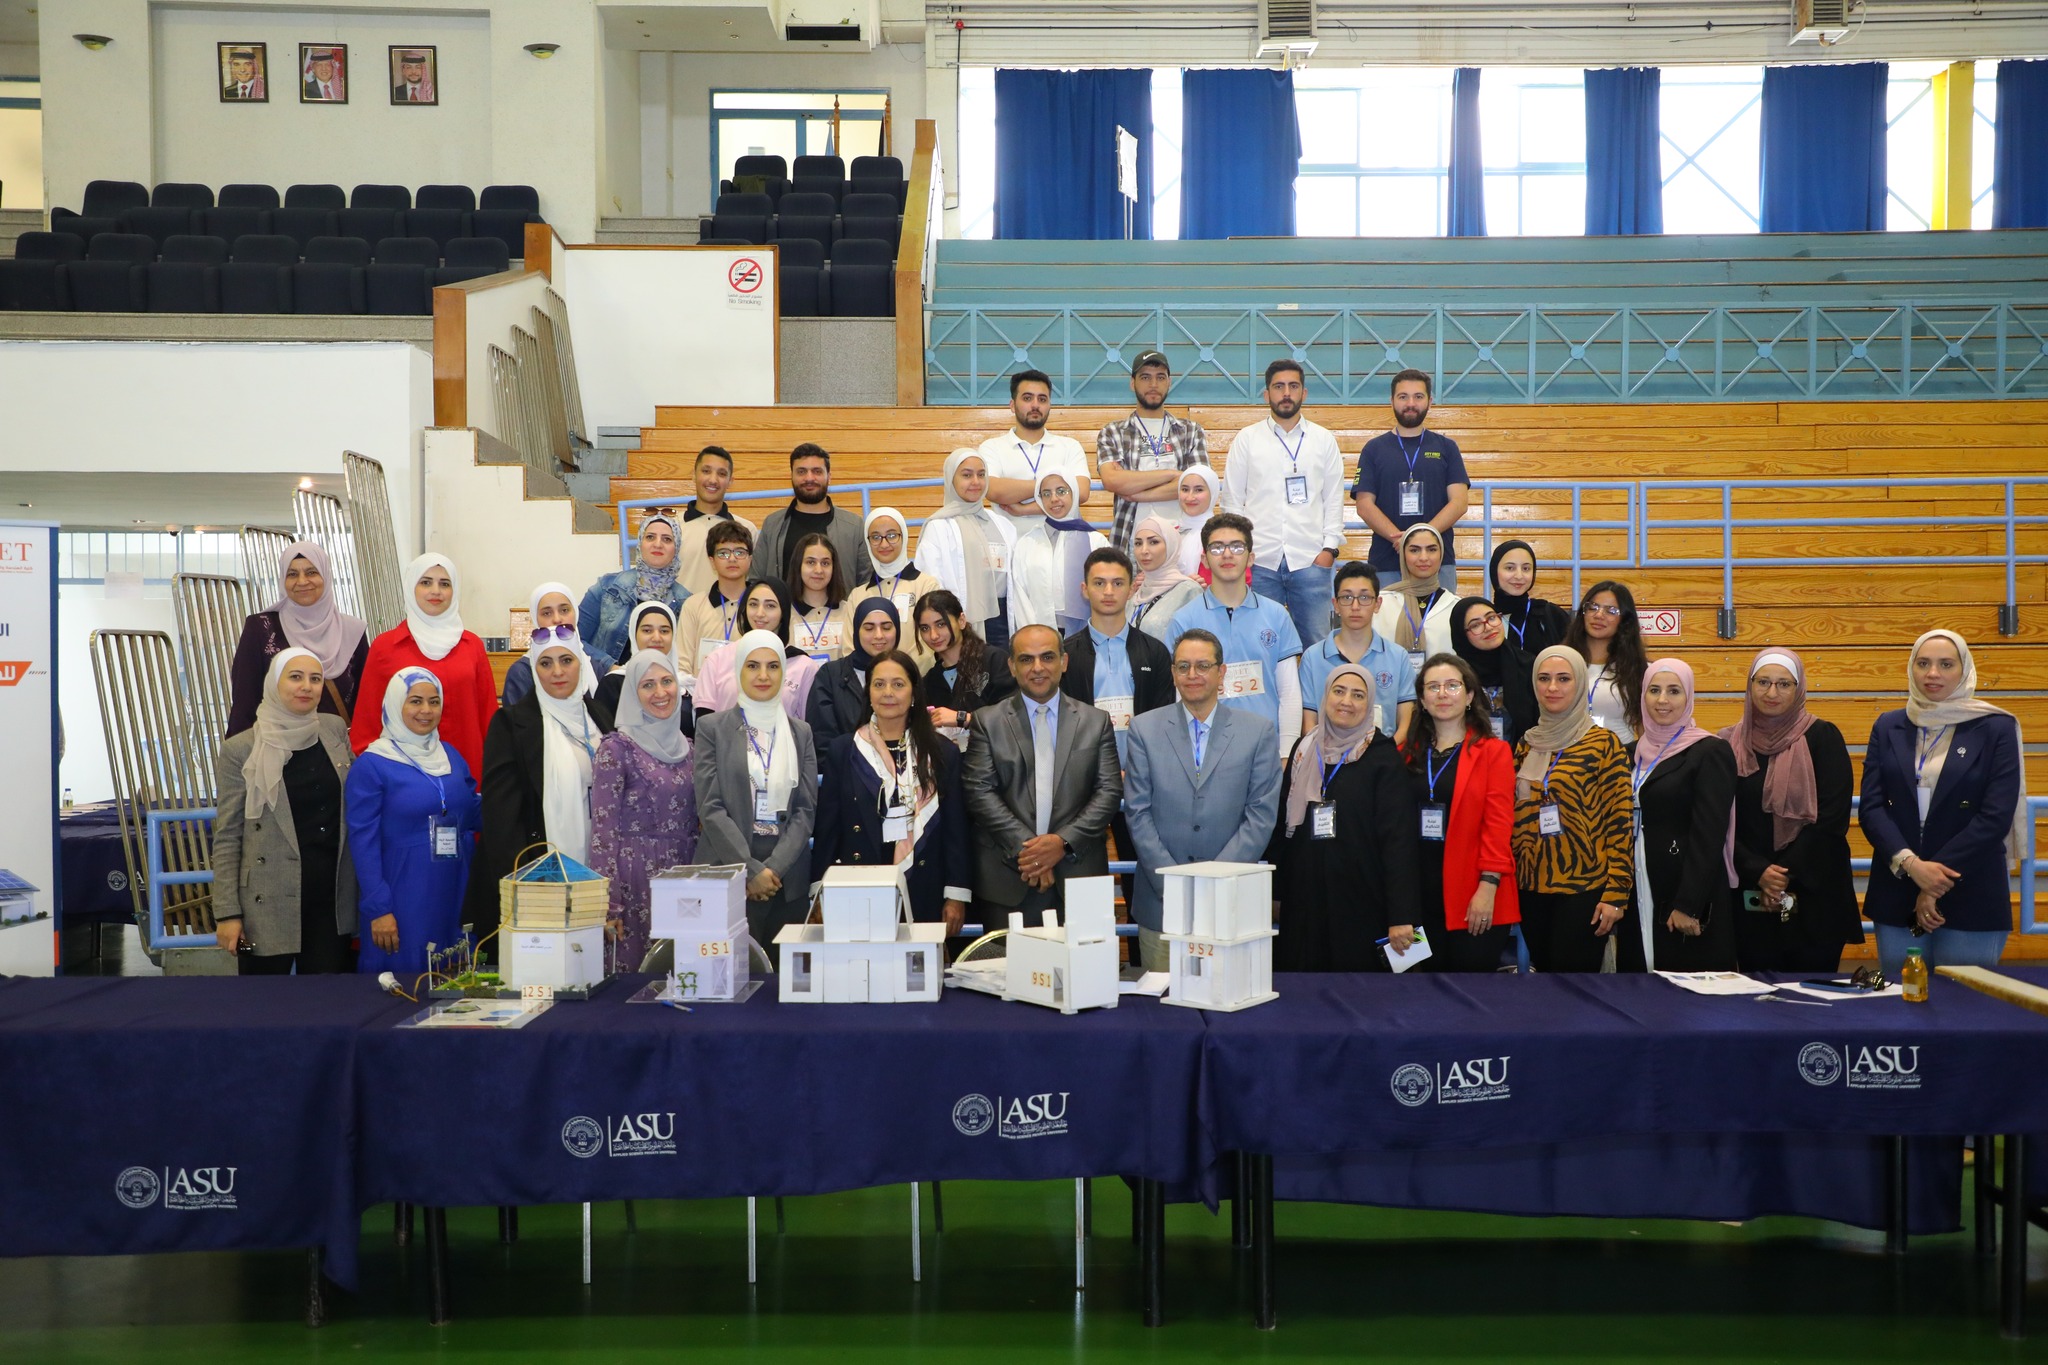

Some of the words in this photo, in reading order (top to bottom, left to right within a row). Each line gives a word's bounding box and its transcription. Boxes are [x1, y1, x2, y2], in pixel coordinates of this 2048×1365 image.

[802, 636, 815, 646] 12
[821, 636, 829, 646] S
[834, 635, 840, 645] 1
[1233, 681, 1243, 693] S
[1250, 679, 1258, 691] 2
[523, 986, 534, 998] 12
[538, 986, 544, 997] S
[548, 986, 552, 997] 1
[1441, 1056, 1511, 1088] ASU
[1850, 1046, 1920, 1074] ASU
[1002, 1092, 1070, 1124] ASU
[612, 1113, 676, 1142] ASU
[169, 1167, 237, 1195] ASU
